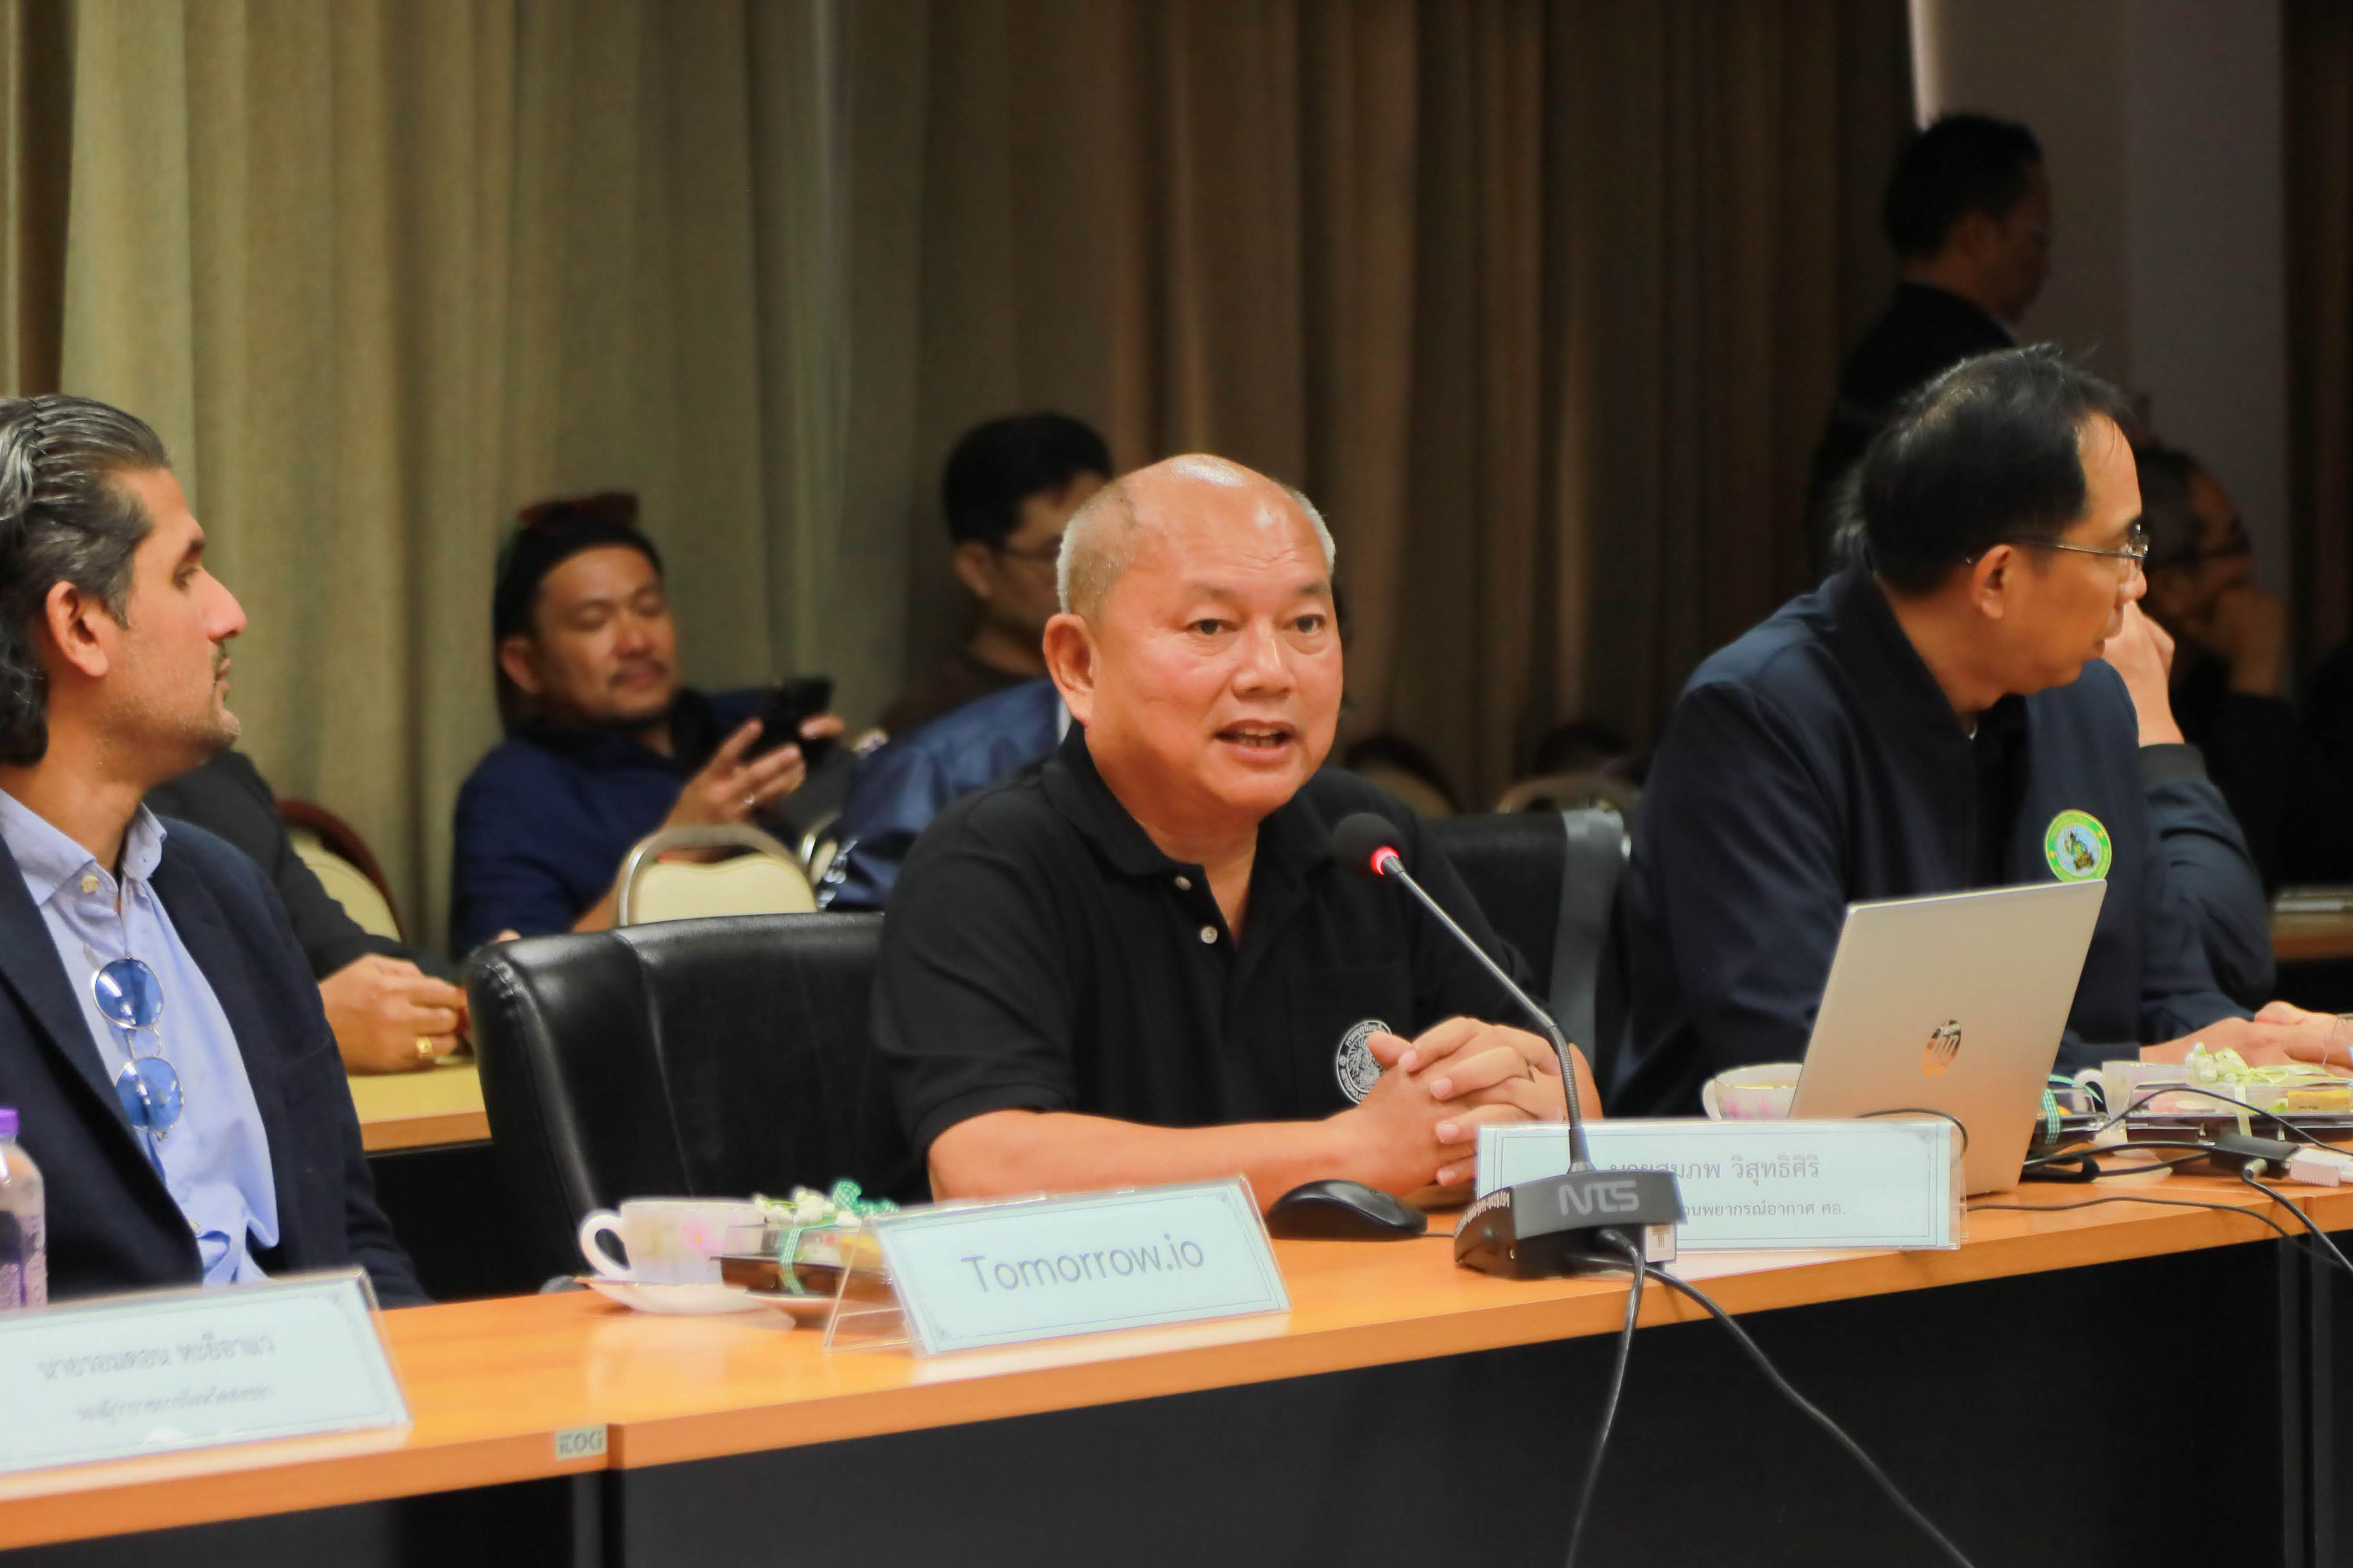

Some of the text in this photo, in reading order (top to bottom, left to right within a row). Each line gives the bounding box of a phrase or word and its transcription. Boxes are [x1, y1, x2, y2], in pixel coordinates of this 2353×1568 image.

[1730, 1155, 1820, 1186] วิสุทธิศิริ
[1558, 1180, 1639, 1216] NTS
[1683, 1198, 1814, 1217] วนพยากรณ์อากาศ
[960, 1233, 1205, 1293] Tomorrow.io
